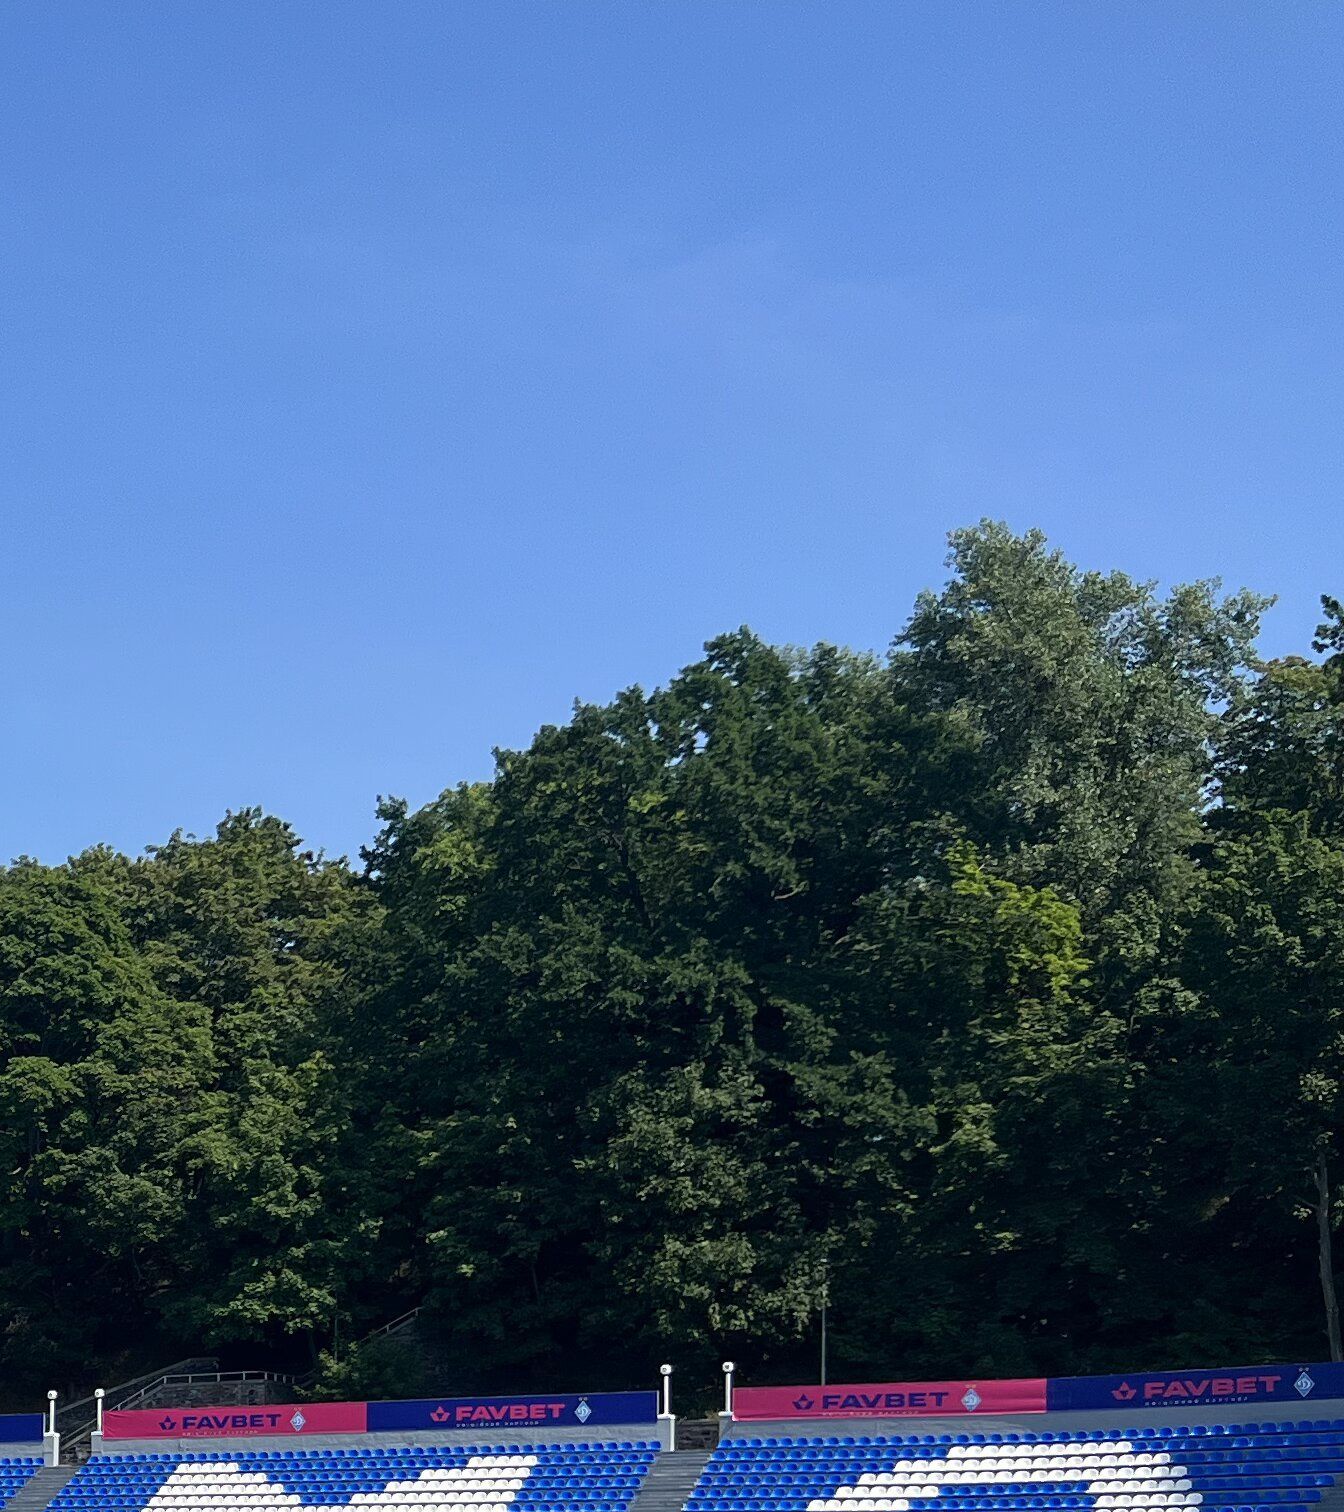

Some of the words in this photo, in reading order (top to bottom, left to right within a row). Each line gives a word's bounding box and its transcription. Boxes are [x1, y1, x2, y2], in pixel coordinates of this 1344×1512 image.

[1144, 1375, 1282, 1399] FAVBET
[821, 1391, 949, 1410] FAVBET
[455, 1403, 566, 1421] FAVBET
[181, 1413, 282, 1430] FAVBET
